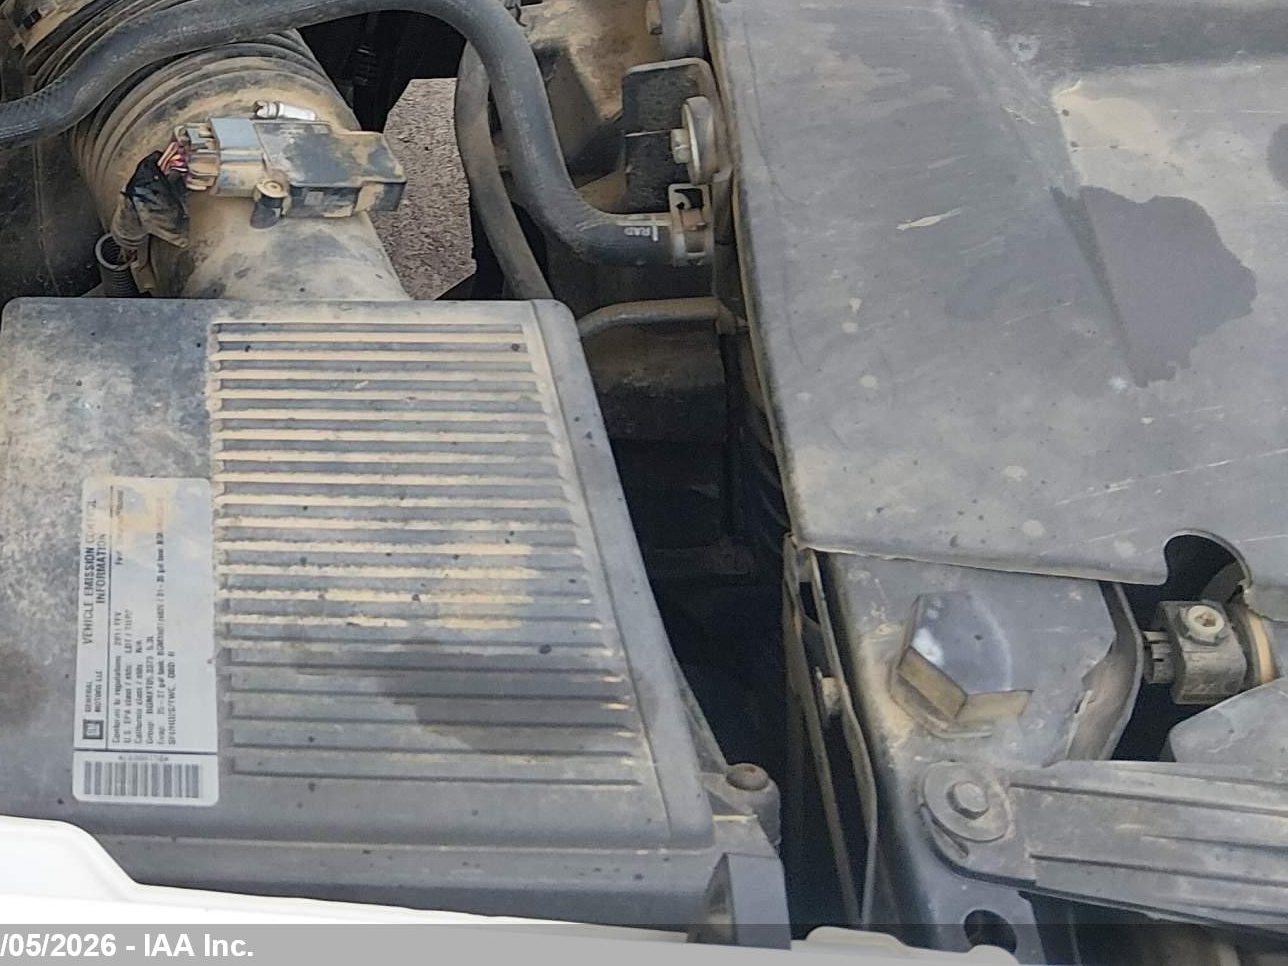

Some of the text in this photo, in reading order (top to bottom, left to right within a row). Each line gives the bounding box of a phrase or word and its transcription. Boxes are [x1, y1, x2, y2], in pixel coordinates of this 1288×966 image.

[84, 548, 95, 596] EMISSION
[96, 534, 107, 604] INFORMATION
[83, 602, 94, 645] VEHICLE
